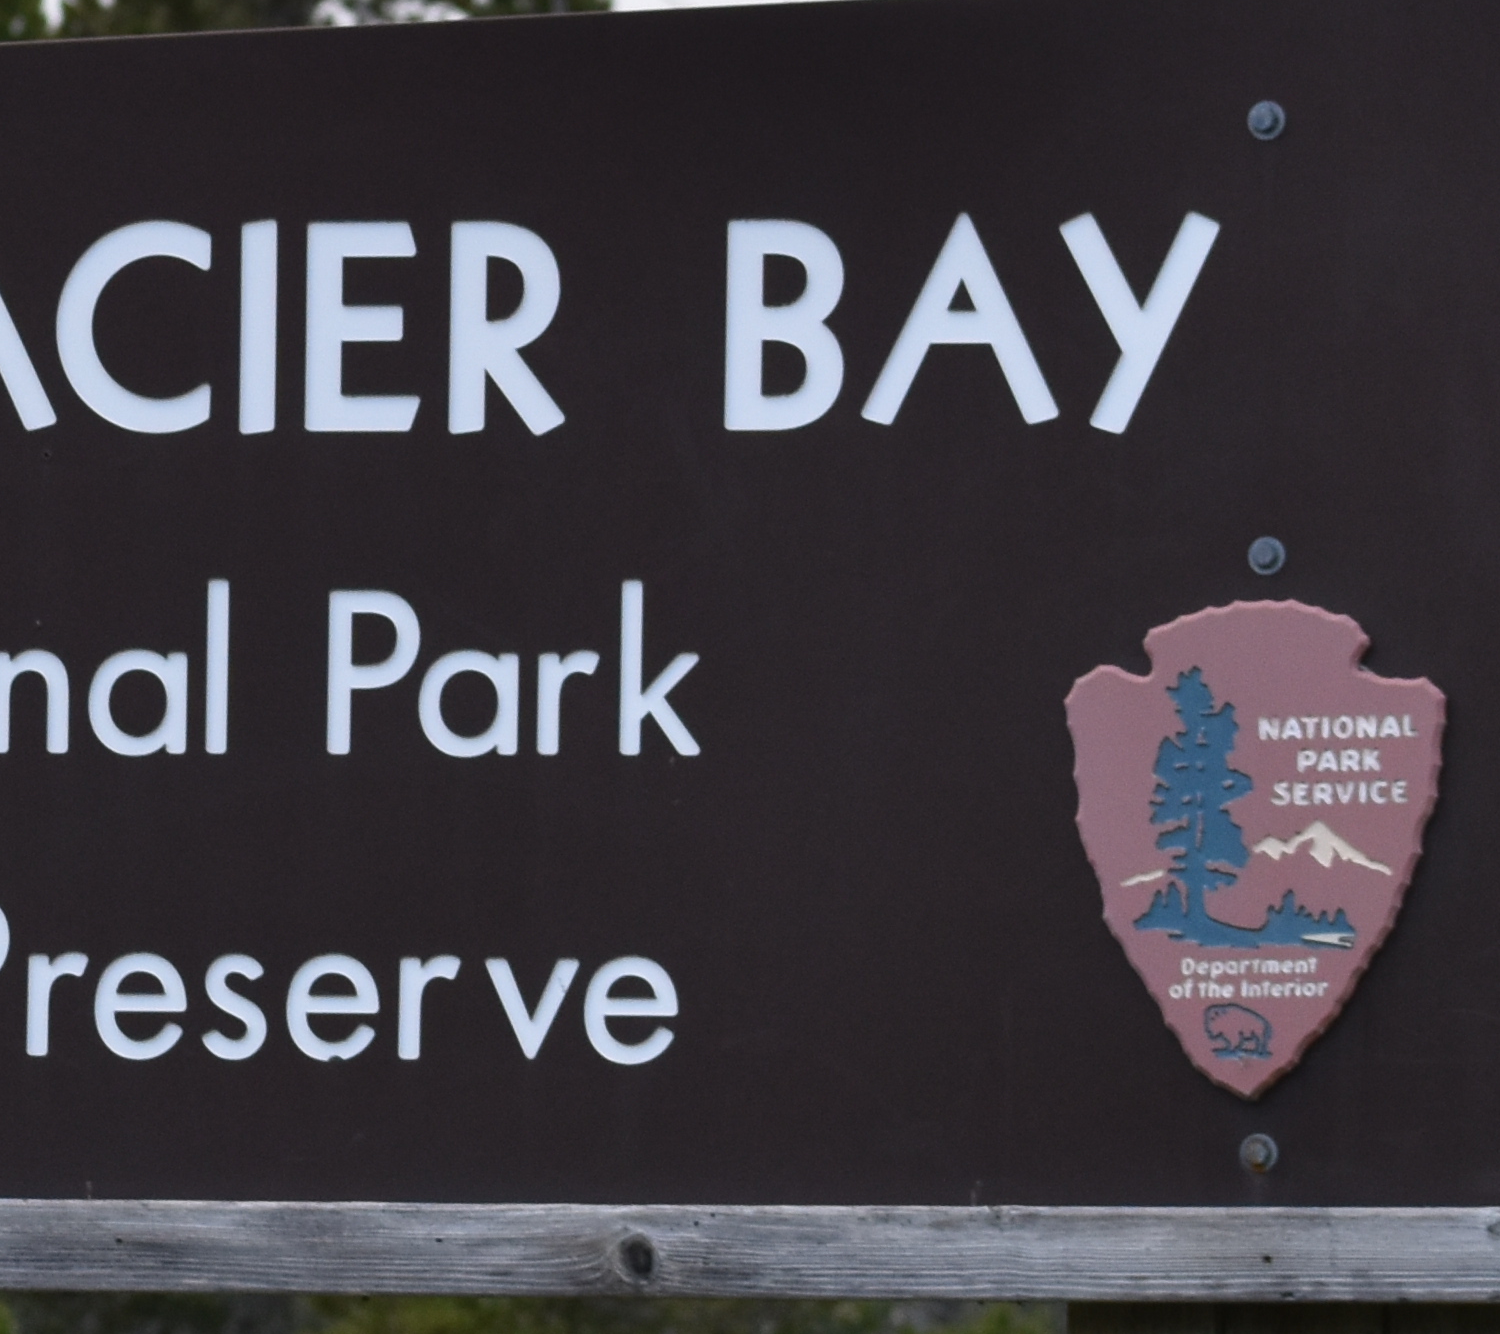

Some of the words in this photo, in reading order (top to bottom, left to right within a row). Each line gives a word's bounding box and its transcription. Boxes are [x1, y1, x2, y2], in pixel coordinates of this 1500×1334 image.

[723, 212, 1221, 435] BAY
[326, 580, 701, 759] Park
[1257, 714, 1418, 741] NATIONAL
[1297, 749, 1381, 773] PARK
[1270, 780, 1409, 806] SERVICE
[1181, 956, 1318, 980] Department
[1168, 980, 1195, 1000] of
[1199, 979, 1235, 999] the
[1240, 978, 1329, 998] Interior
